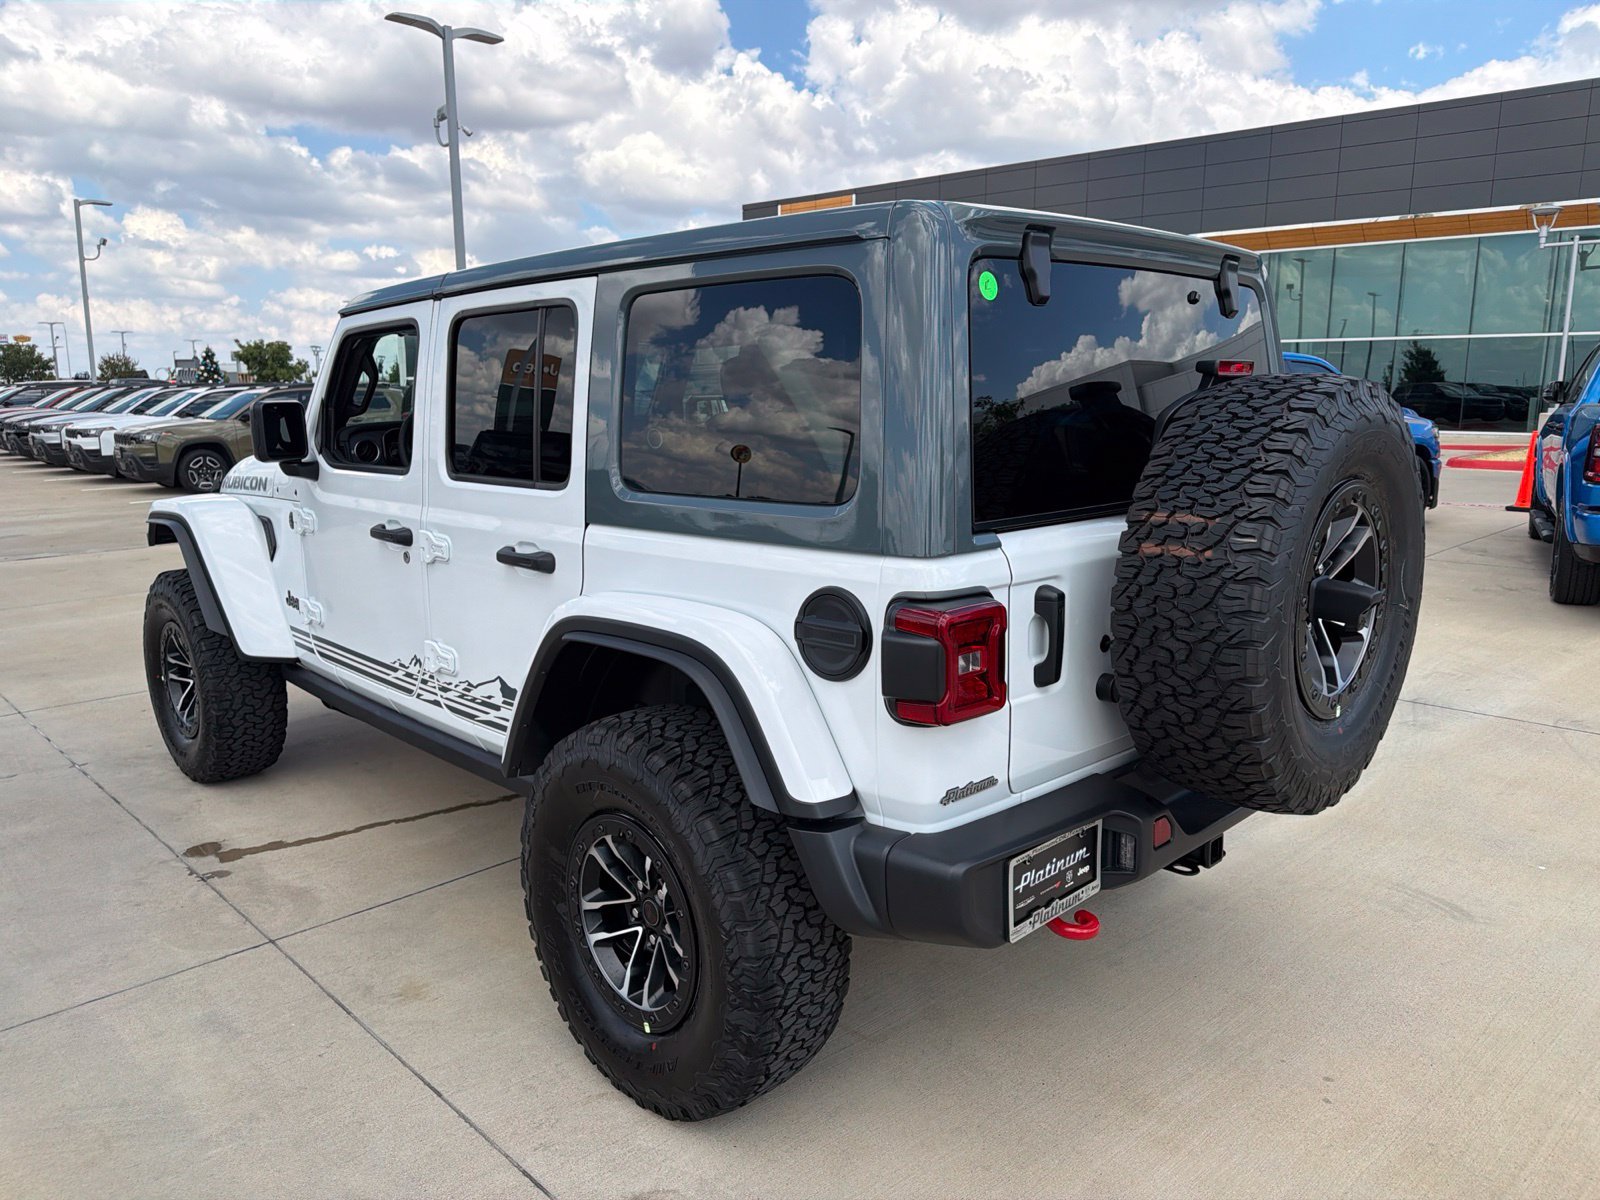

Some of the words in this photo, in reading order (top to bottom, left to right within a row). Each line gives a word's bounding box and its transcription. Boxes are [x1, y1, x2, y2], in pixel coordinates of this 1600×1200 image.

[940, 775, 998, 806] Platinum
[1014, 846, 1090, 893] Platinum
[1077, 865, 1090, 876] Jeep
[1031, 891, 1083, 930] Platinum
